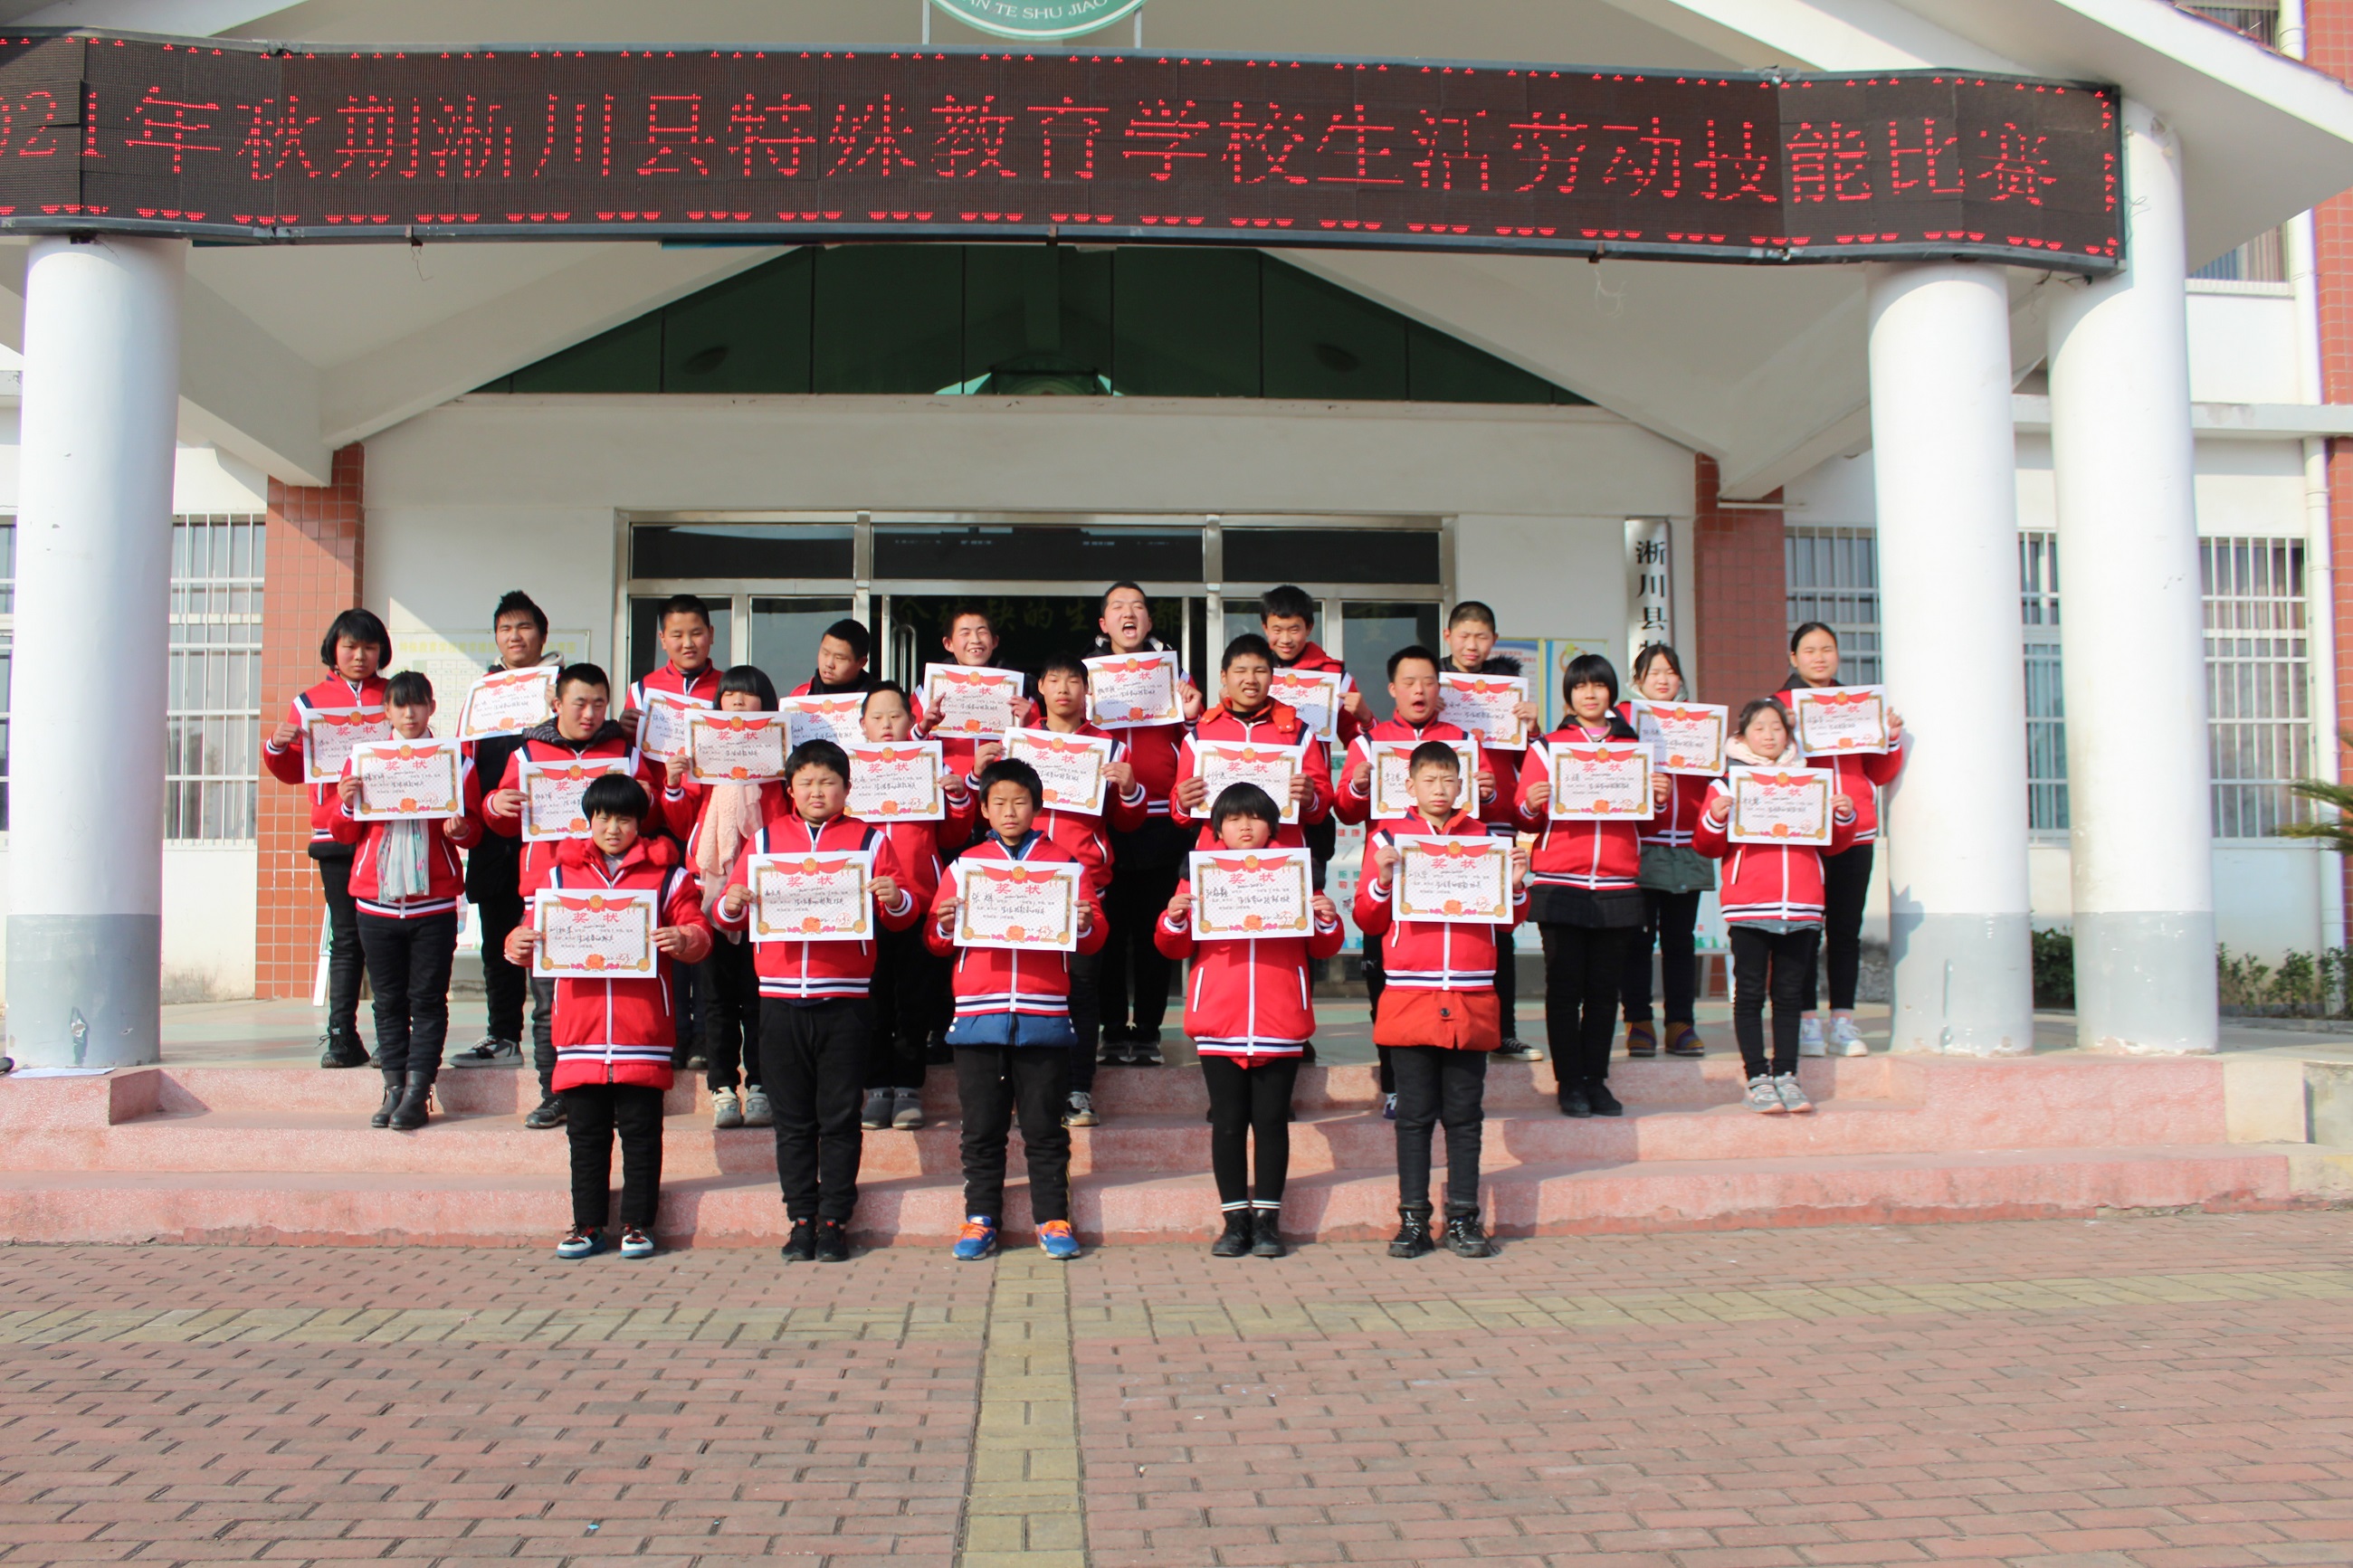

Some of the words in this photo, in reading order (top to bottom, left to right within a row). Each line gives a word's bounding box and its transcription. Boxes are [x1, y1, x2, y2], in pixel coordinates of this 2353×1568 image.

[996, 2, 1017, 17] TE
[1023, 6, 1062, 19] SHU
[1635, 540, 1668, 650] 淅川县
[1115, 671, 1152, 683] 奖状
[956, 684, 992, 696] 奖状
[1272, 686, 1310, 698] 奖状
[1461, 692, 1498, 703] 奖状
[1824, 704, 1861, 716] 奖状
[809, 714, 844, 724] 奖状
[1662, 719, 1699, 730] 奖状
[336, 725, 377, 736] 奖状
[717, 730, 759, 741] 奖状
[1036, 750, 1077, 765] 奖状
[385, 760, 428, 771] 奖状
[868, 762, 910, 774] 奖状
[1227, 761, 1269, 774] 奖状
[1583, 762, 1623, 773] 奖状
[1763, 786, 1802, 796] 奖状
[1431, 857, 1477, 870] 奖状
[786, 875, 834, 888] 奖状
[1229, 872, 1276, 885] 奖状
[996, 882, 1043, 896] 奖状
[573, 911, 620, 924] 奖状
